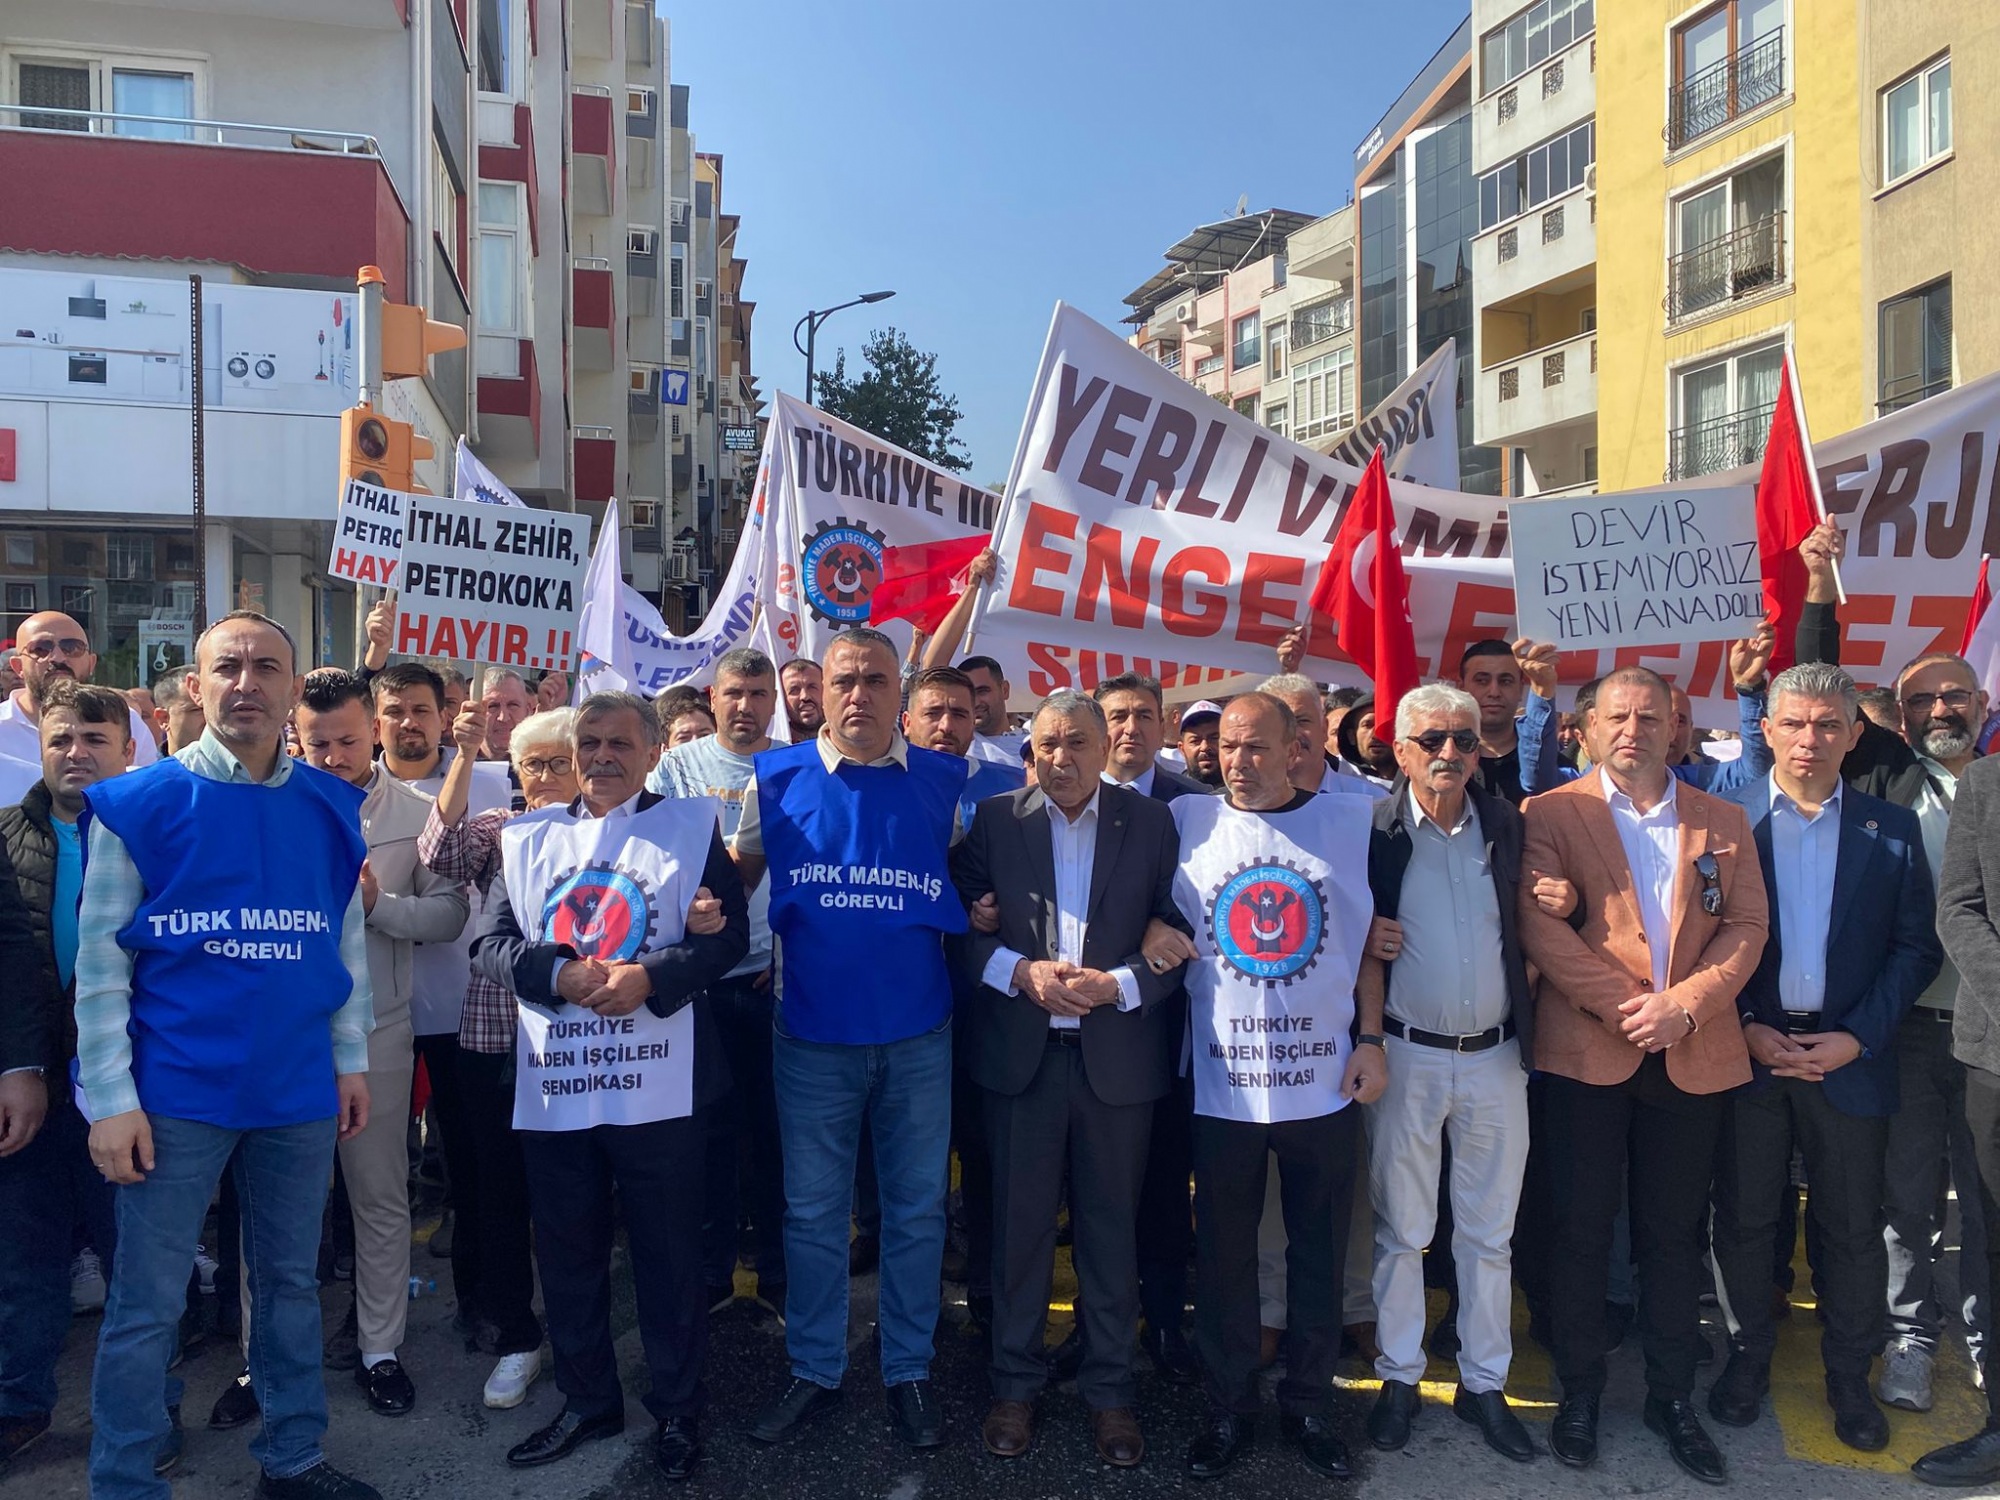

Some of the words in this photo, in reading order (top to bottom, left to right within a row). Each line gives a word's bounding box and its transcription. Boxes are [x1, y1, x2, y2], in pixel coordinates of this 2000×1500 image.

[725, 428, 756, 438] AVUKAT
[347, 479, 400, 515] İTHAL
[408, 500, 487, 550] İTHAL
[494, 518, 579, 566] ZEHİR,
[1571, 499, 1706, 549] DEVİR
[812, 532, 843, 557] MADEN
[1543, 541, 1762, 596] İSTEMİYORUZ
[405, 562, 573, 612] PETROKOK'A
[835, 608, 857, 618] 1958
[1547, 596, 1624, 639] YENİ
[1634, 593, 1765, 631] ANADOLU
[156, 623, 185, 631] BOSCH
[397, 612, 571, 671] HAYIR.!!
[789, 862, 844, 886] TÜRK
[849, 865, 943, 901] MADEN-İŞ
[1228, 872, 1259, 897] MADEN
[820, 891, 904, 911] GÖREVLİ
[148, 908, 232, 938] TÜRK
[203, 938, 302, 960] GÖREVLİ
[1253, 962, 1289, 974] 1958
[546, 1016, 635, 1039] TÜRKİYE
[1229, 1014, 1313, 1033] TÜRKİYE
[527, 1052, 575, 1069] MADEN
[583, 1039, 669, 1066] İŞÇİLERİ
[1209, 1043, 1264, 1060] MADEN
[1269, 1037, 1337, 1063] İŞÇİLERİ
[542, 1073, 642, 1096] SENDİKASI
[1228, 1068, 1315, 1088] SENDİKASI
